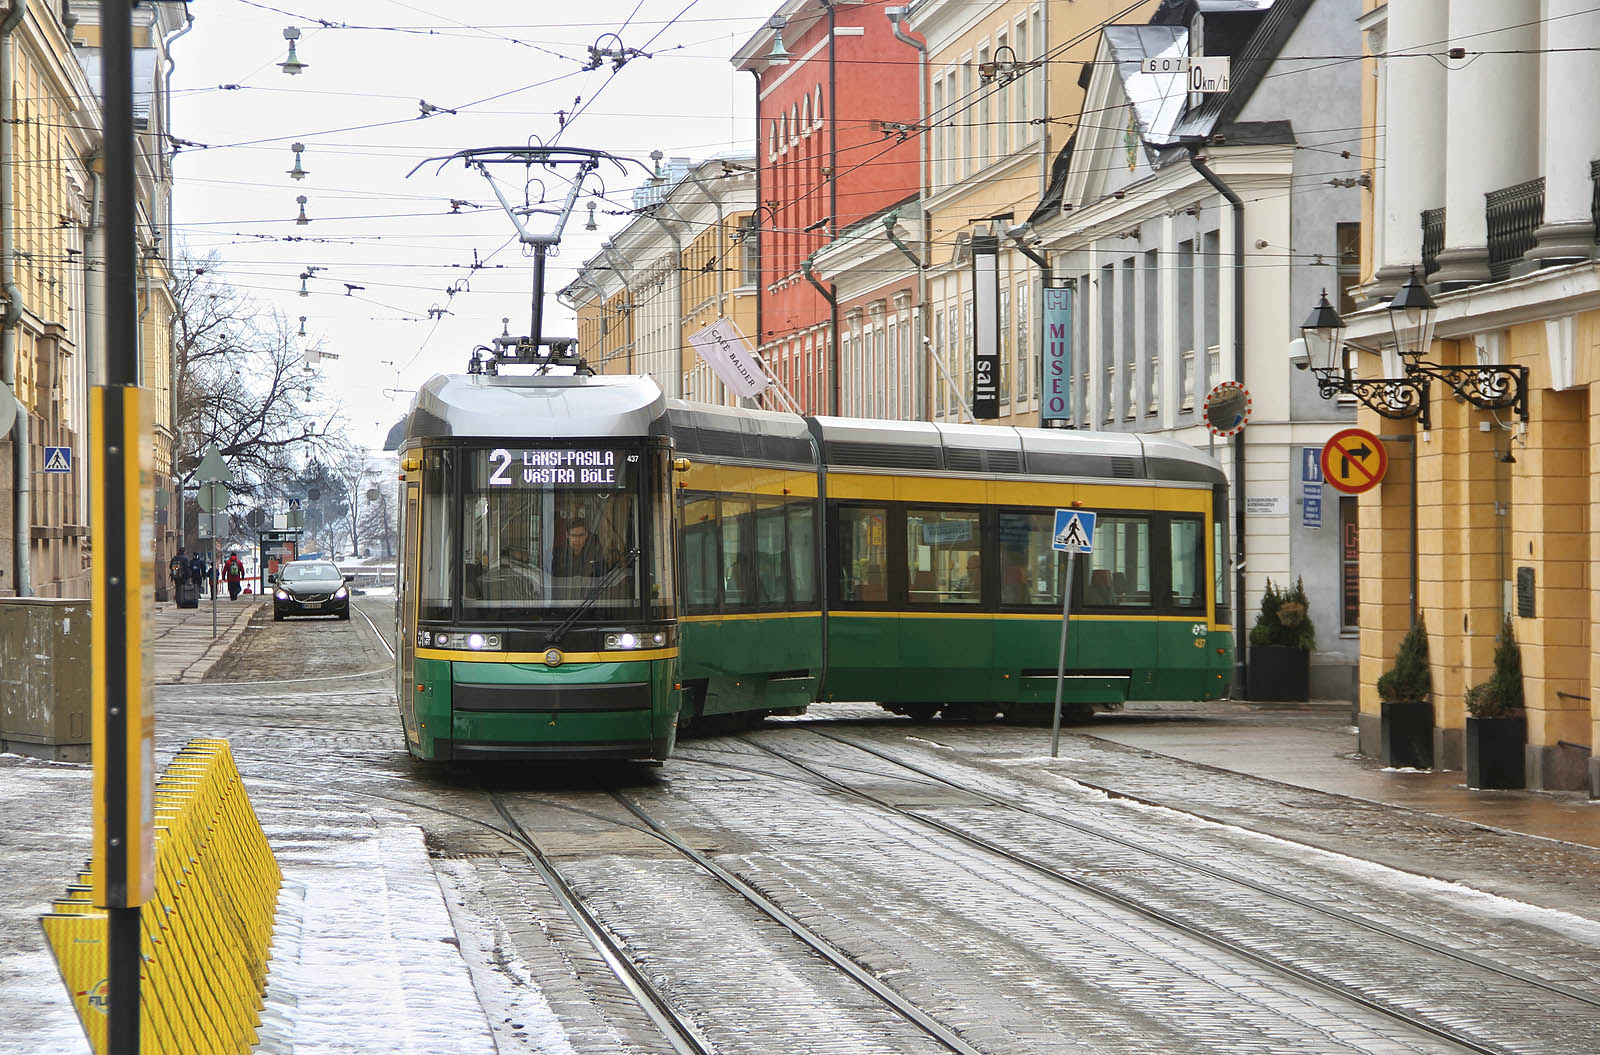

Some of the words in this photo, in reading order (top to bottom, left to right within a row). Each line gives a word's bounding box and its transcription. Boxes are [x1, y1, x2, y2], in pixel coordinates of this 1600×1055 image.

[729, 353, 756, 387] BALDER
[977, 360, 996, 400] sali
[1049, 323, 1065, 412] MUSEO
[490, 449, 512, 485] 2
[523, 451, 614, 466] LÄNSI-PASILA
[523, 468, 575, 483] VÄSTRA
[580, 468, 615, 483] BÖLE
[627, 455, 639, 463] 437
